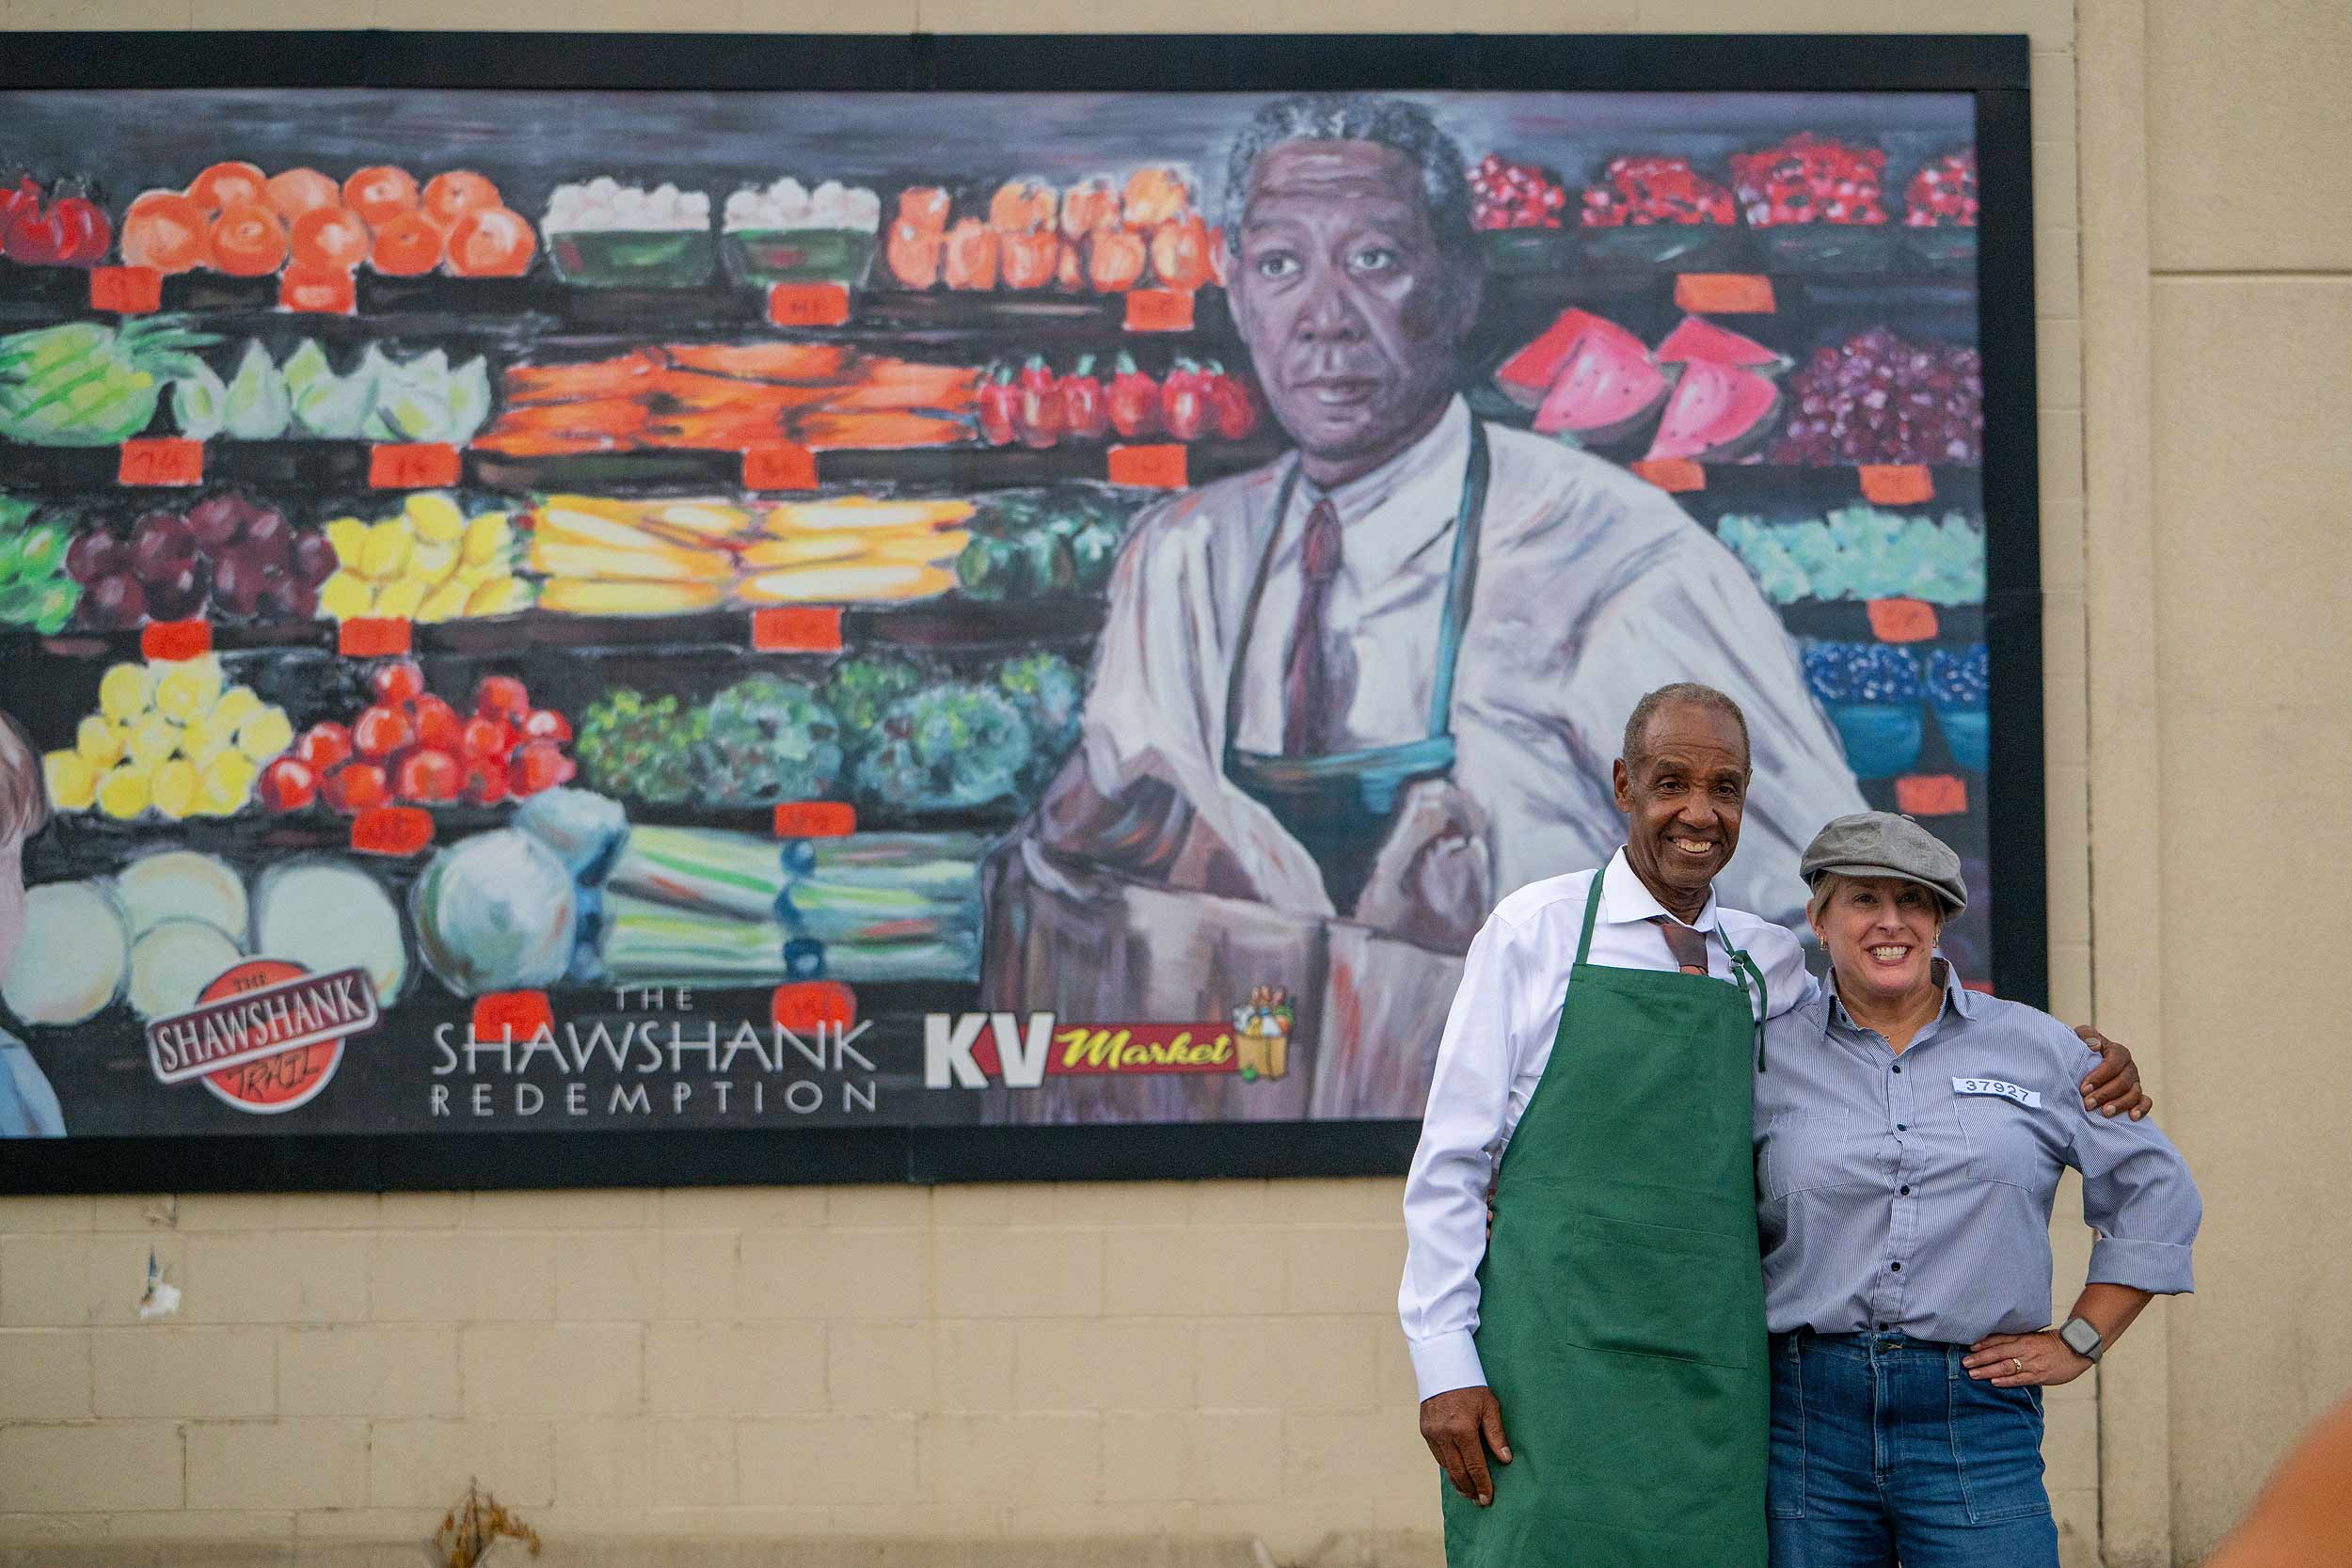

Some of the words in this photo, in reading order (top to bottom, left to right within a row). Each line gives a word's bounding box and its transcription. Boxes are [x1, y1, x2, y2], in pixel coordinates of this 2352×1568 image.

[614, 986, 693, 1011] THE
[157, 976, 364, 1071] SHAWSHANK
[432, 1021, 877, 1074] SHAWSHANK
[924, 1012, 1055, 1089] KV
[1055, 1028, 1233, 1069] Market
[431, 1081, 877, 1117] REDEMPTION
[1965, 1080, 2029, 1101] 37927
